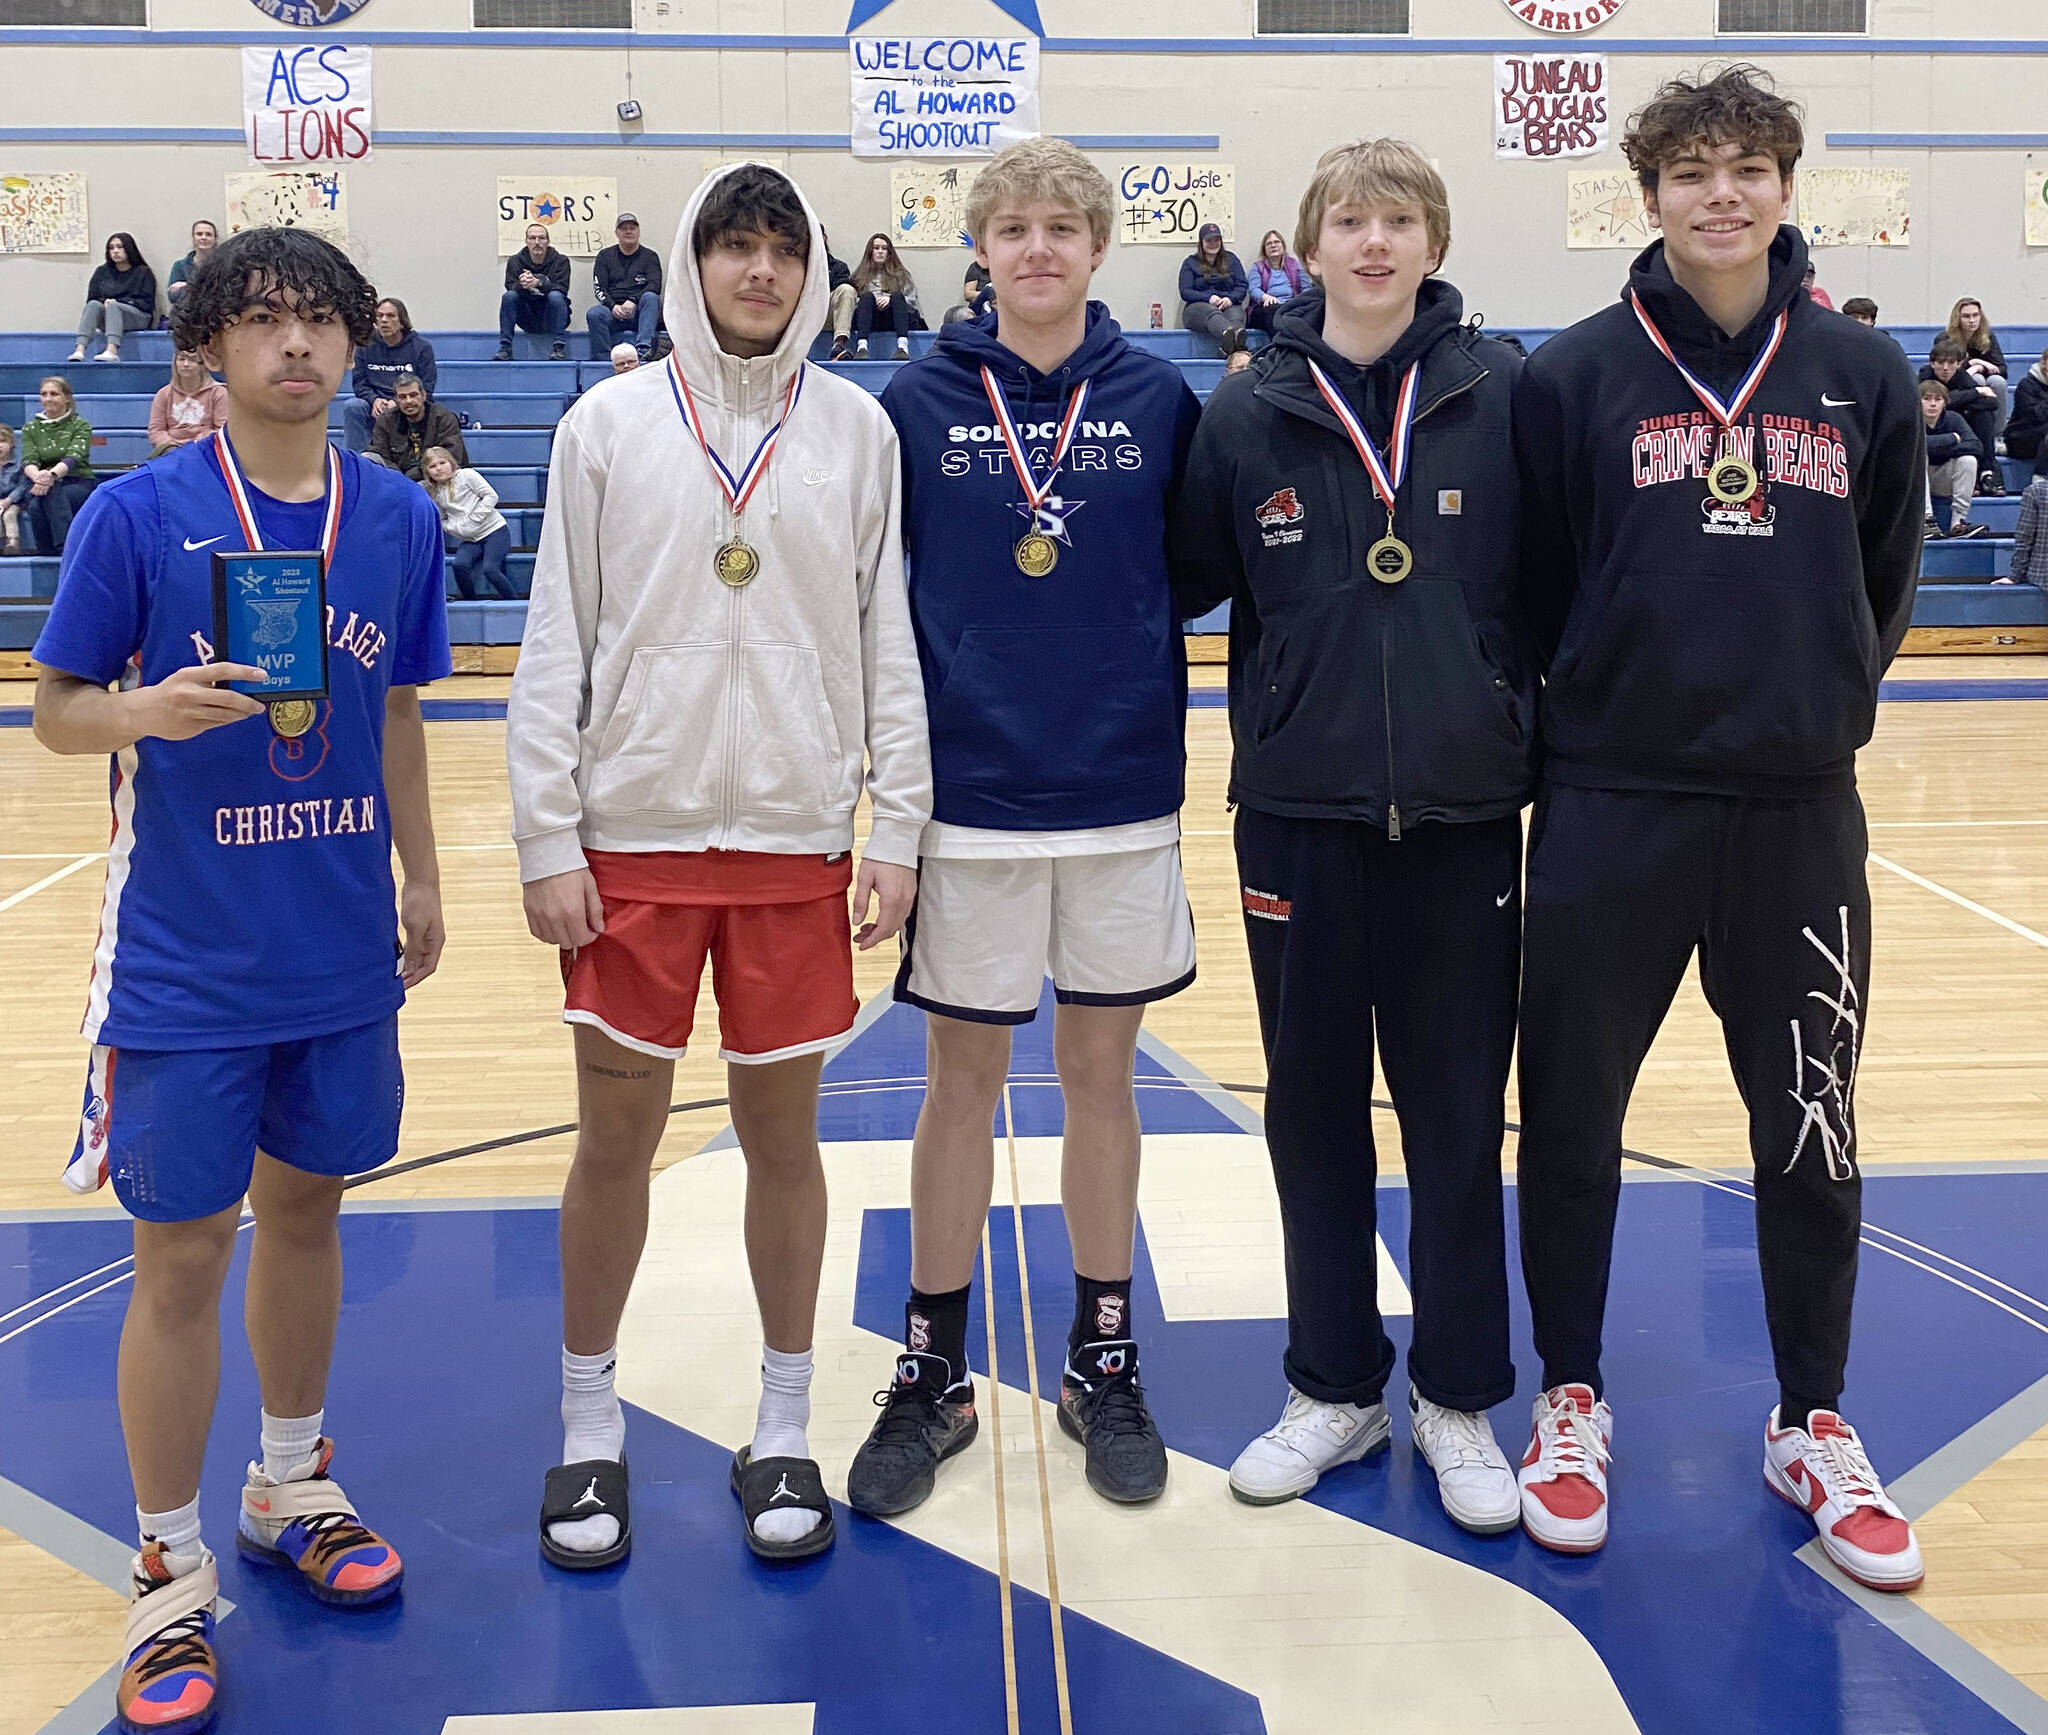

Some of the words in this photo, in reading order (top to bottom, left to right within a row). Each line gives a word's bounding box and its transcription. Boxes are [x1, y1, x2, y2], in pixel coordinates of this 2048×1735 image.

[855, 40, 1027, 72] WELCOME
[266, 45, 350, 106] ACS
[911, 74, 923, 87] to
[932, 75, 956, 88] the
[1501, 60, 1602, 97] JUNEAU
[874, 89, 905, 115] AL
[917, 91, 1016, 115] HOWARD
[1503, 95, 1607, 124] DOUGLAS
[253, 107, 369, 160] LIONS
[879, 120, 1000, 150] SHOOTOUT
[1524, 120, 1597, 155] BEARS
[1121, 165, 1170, 201] GO
[1174, 166, 1223, 191] Josie
[1572, 175, 1621, 200] STARS
[941, 444, 1143, 477] STARS
[1762, 427, 1850, 499] BEARS
[256, 653, 295, 670] MVP
[216, 795, 375, 846] CHRISTIAN
